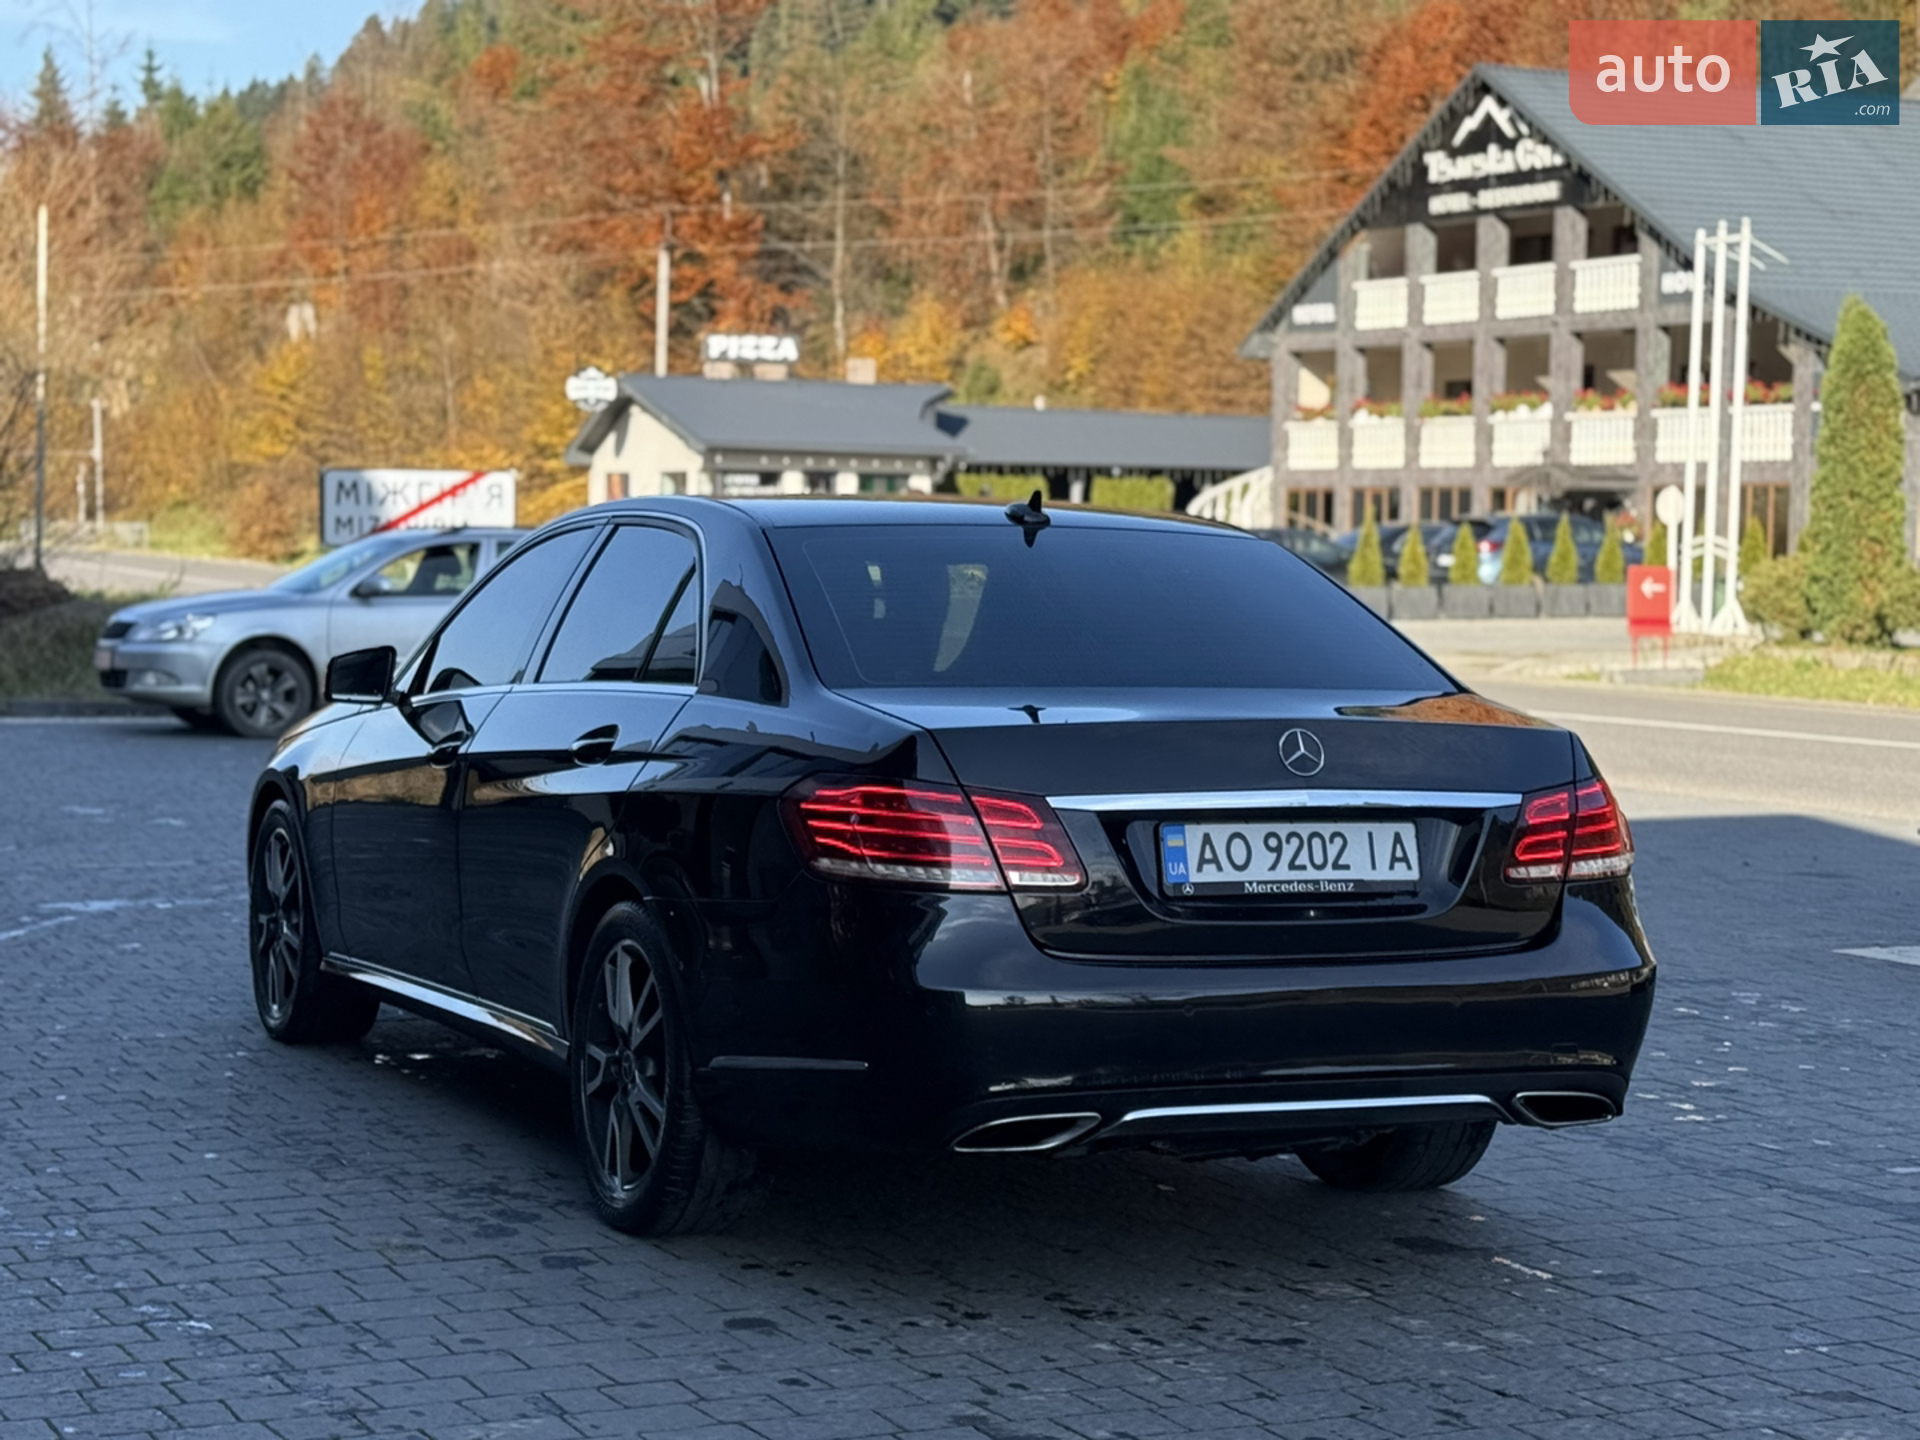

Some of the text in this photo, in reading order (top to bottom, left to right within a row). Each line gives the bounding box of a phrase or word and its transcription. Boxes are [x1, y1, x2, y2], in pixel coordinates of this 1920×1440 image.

[706, 333, 799, 362] PIZZA
[1196, 831, 1253, 873] AO
[1262, 830, 1352, 873] 9202
[1169, 862, 1187, 876] UA
[1243, 880, 1355, 894] Mercedes-Benz
